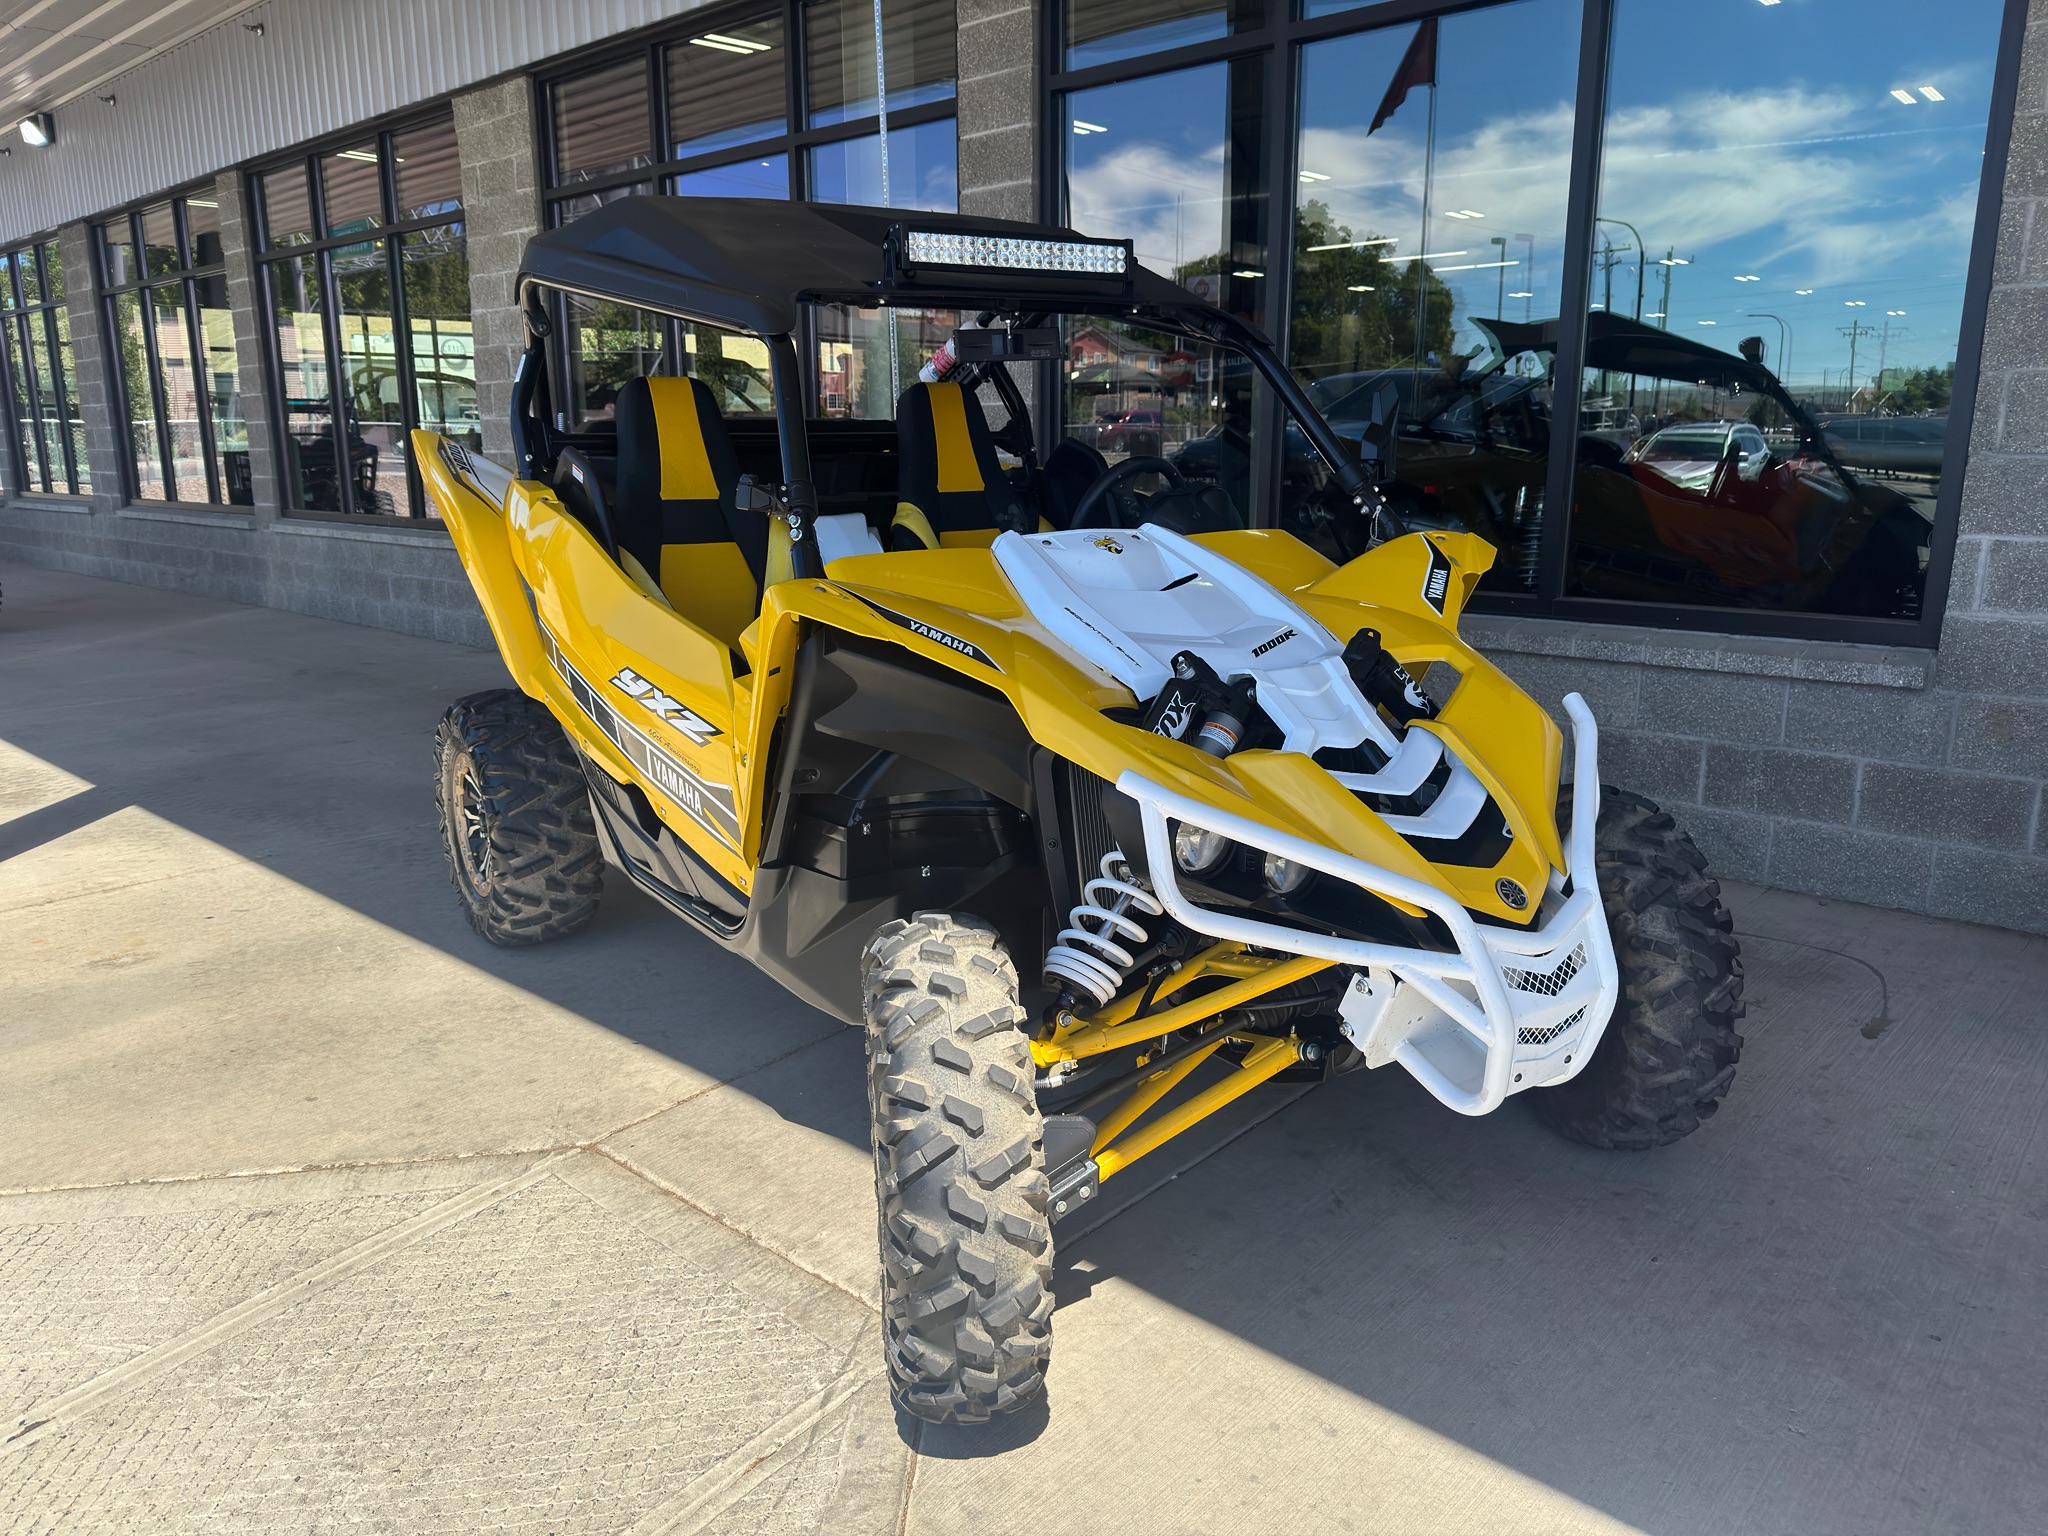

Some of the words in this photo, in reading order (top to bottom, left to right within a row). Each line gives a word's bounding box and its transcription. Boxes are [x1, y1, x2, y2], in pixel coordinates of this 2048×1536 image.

[1427, 569, 1448, 599] YAMAHA
[910, 620, 974, 657] YAMAHA
[1251, 629, 1298, 658] 1000R
[653, 755, 703, 816] YAMAHA
